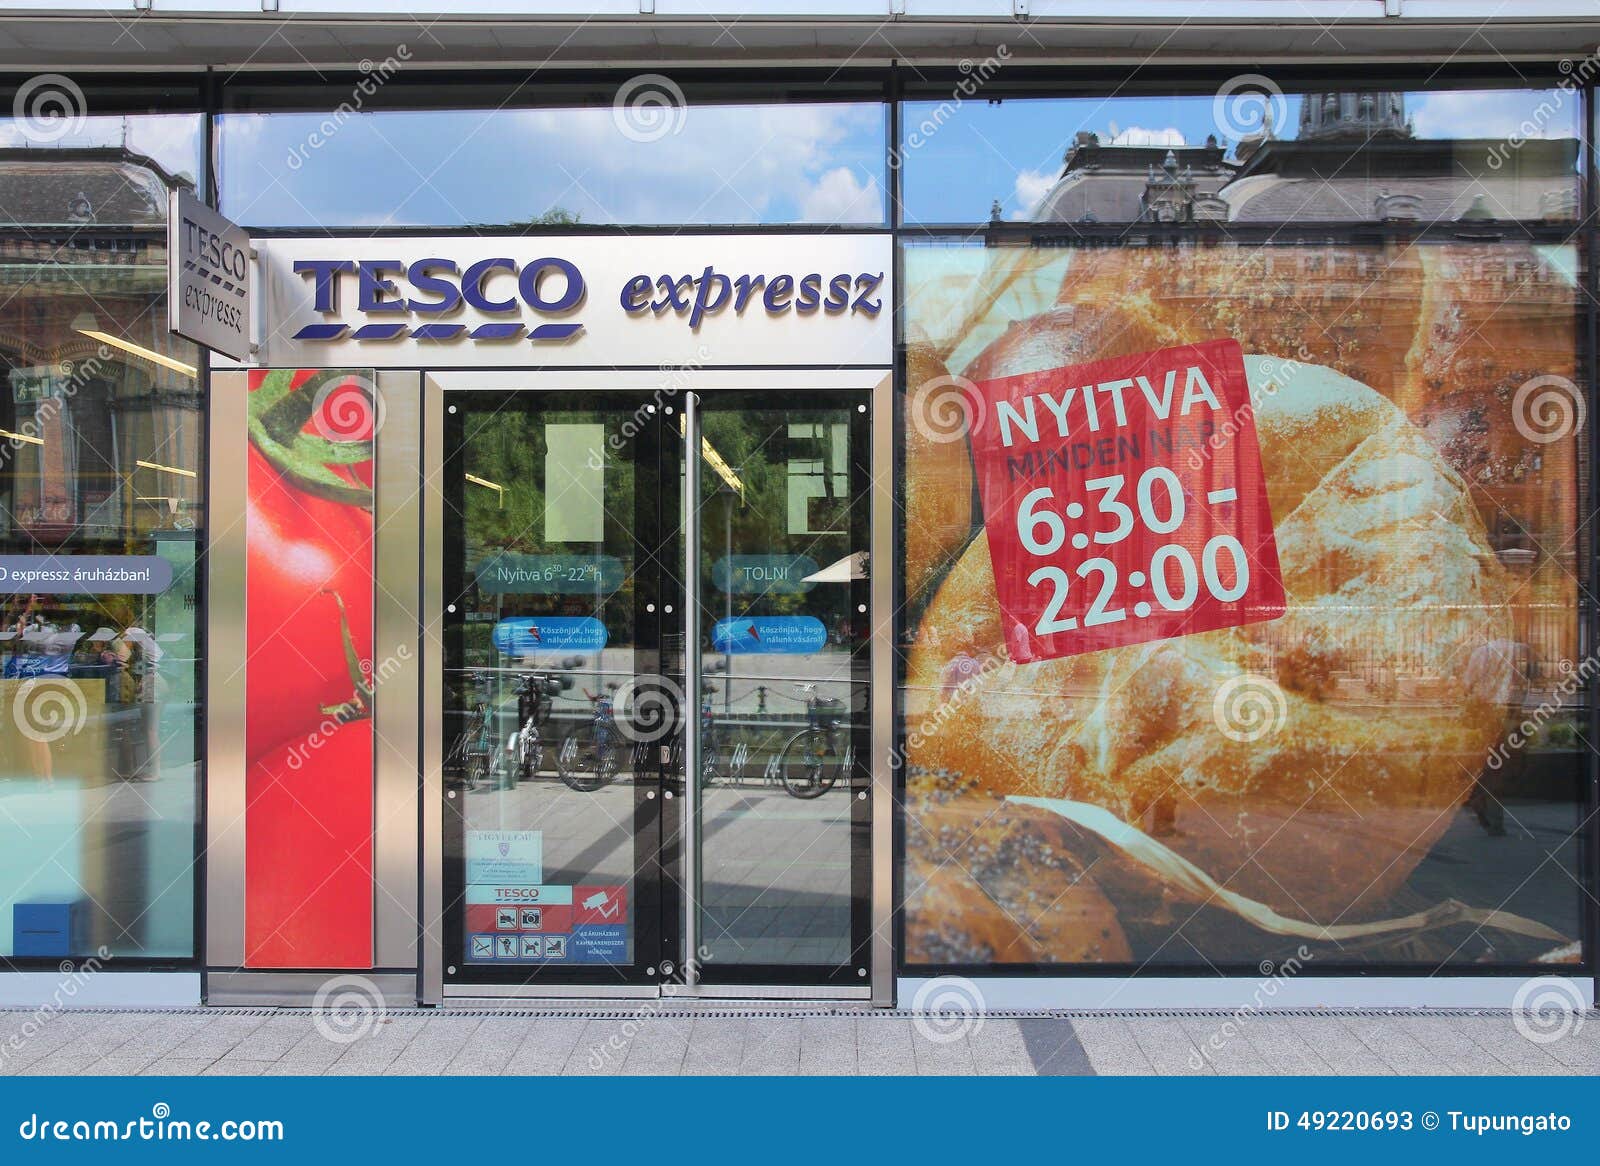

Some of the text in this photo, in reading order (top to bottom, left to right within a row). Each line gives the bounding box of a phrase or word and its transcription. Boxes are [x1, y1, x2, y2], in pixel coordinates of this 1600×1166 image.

[183, 216, 246, 282] TESCO
[185, 284, 243, 334] expressz
[293, 257, 885, 329] TESCO expressz
[995, 366, 1222, 448] NYITVA
[1006, 432, 1141, 483] MINDEN
[1016, 466, 1186, 556] 6:30
[12, 570, 70, 583] expressz
[74, 567, 151, 581] áruházban!
[497, 567, 541, 584] Nyitva
[743, 566, 789, 581] TOLNI
[1026, 534, 1250, 636] 22:00
[494, 888, 540, 898] TESCO
